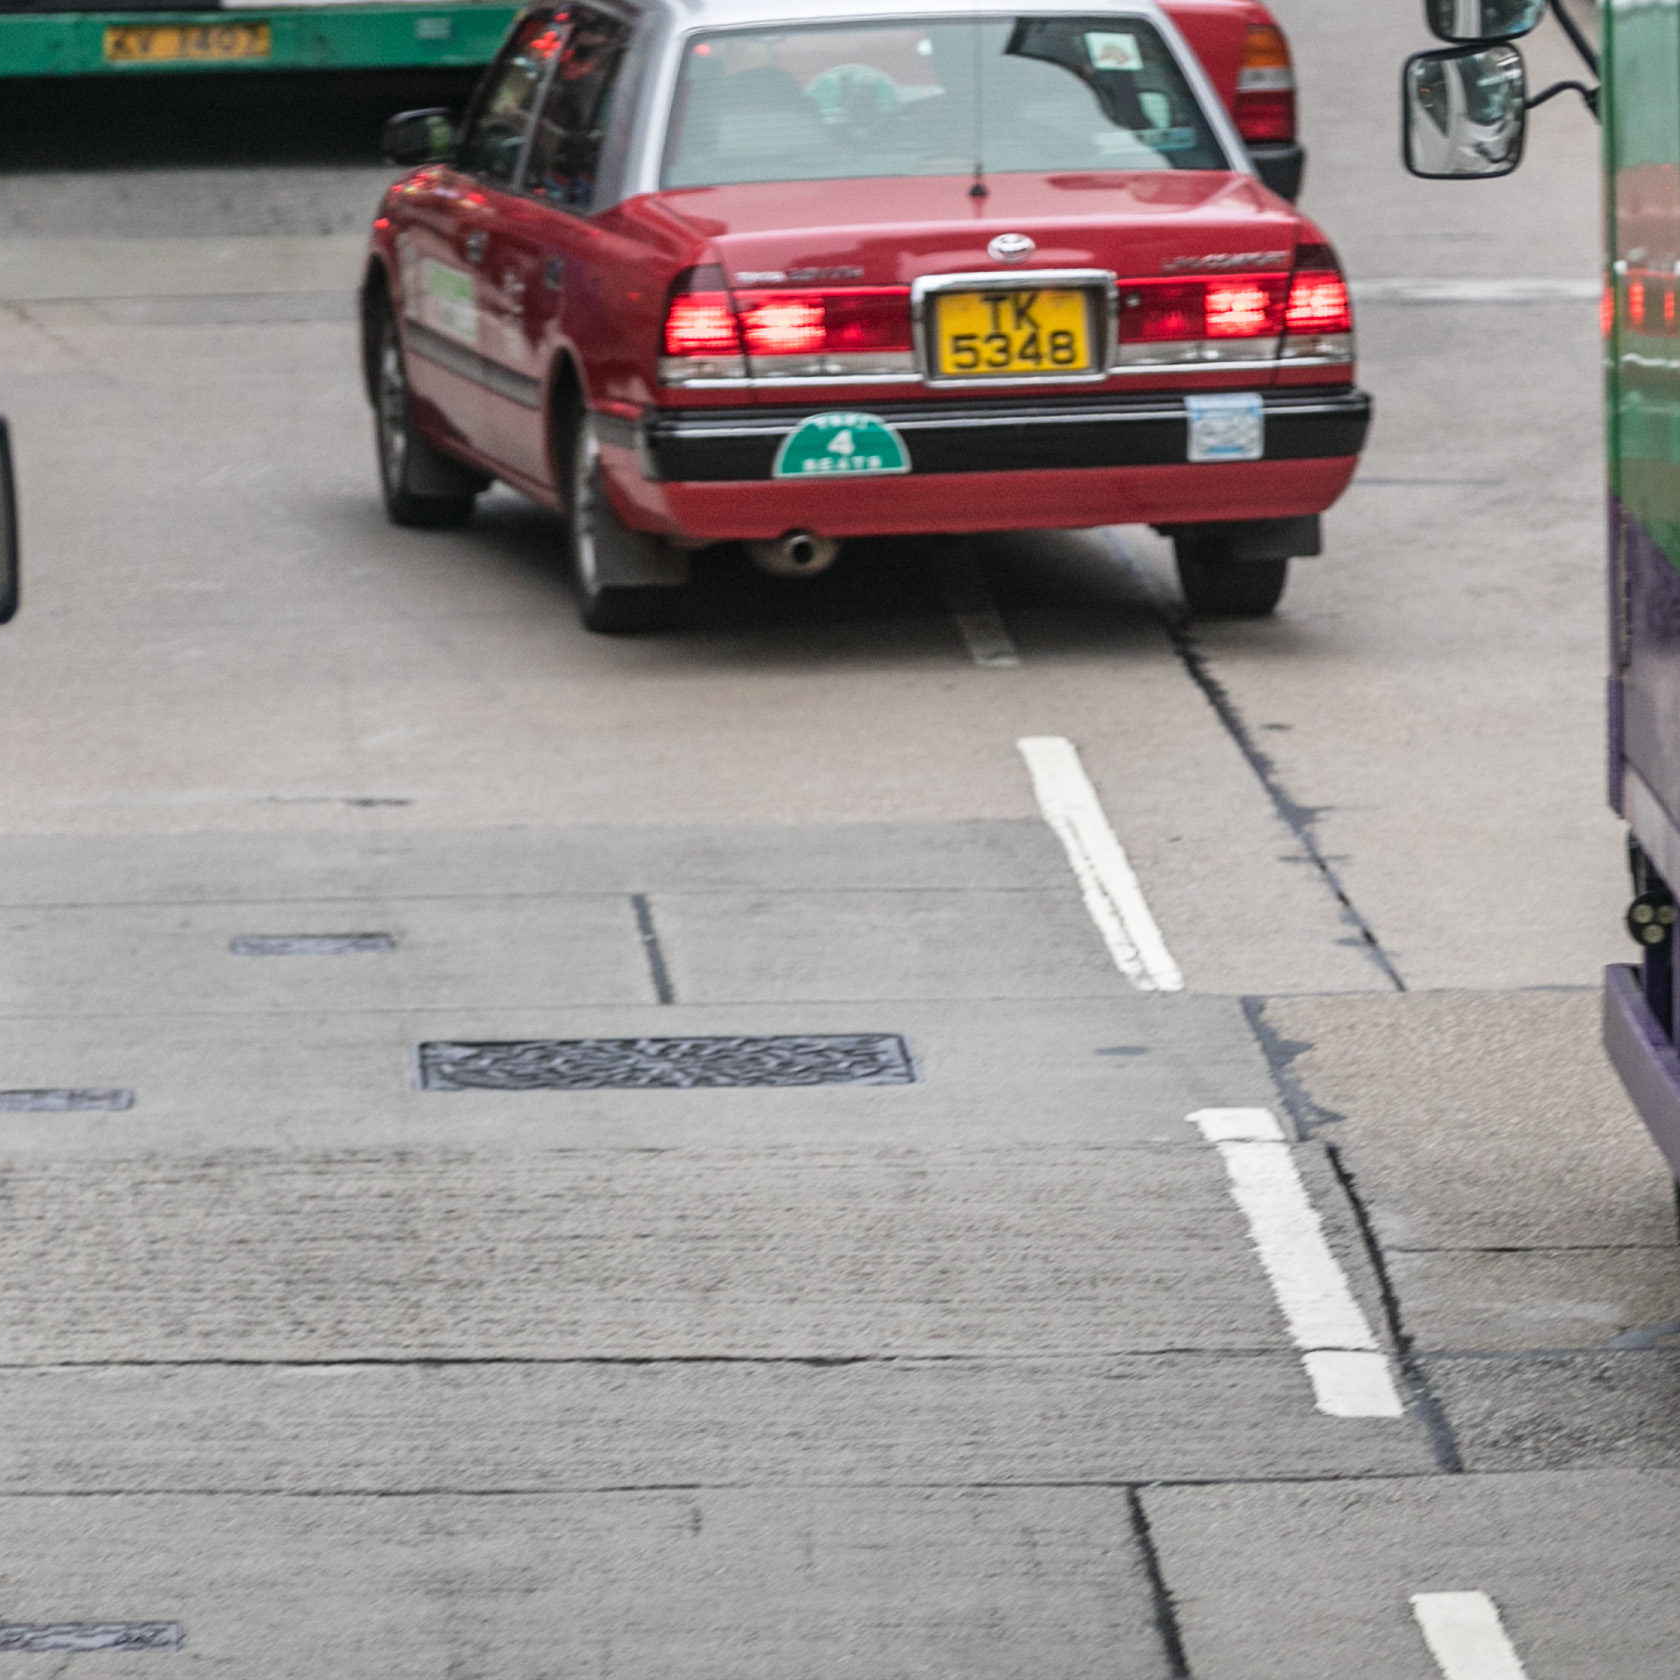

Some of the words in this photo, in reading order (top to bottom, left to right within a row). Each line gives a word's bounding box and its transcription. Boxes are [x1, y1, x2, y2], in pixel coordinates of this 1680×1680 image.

[980, 293, 1042, 333] TK
[951, 329, 1078, 370] 5348
[825, 428, 856, 456] 4
